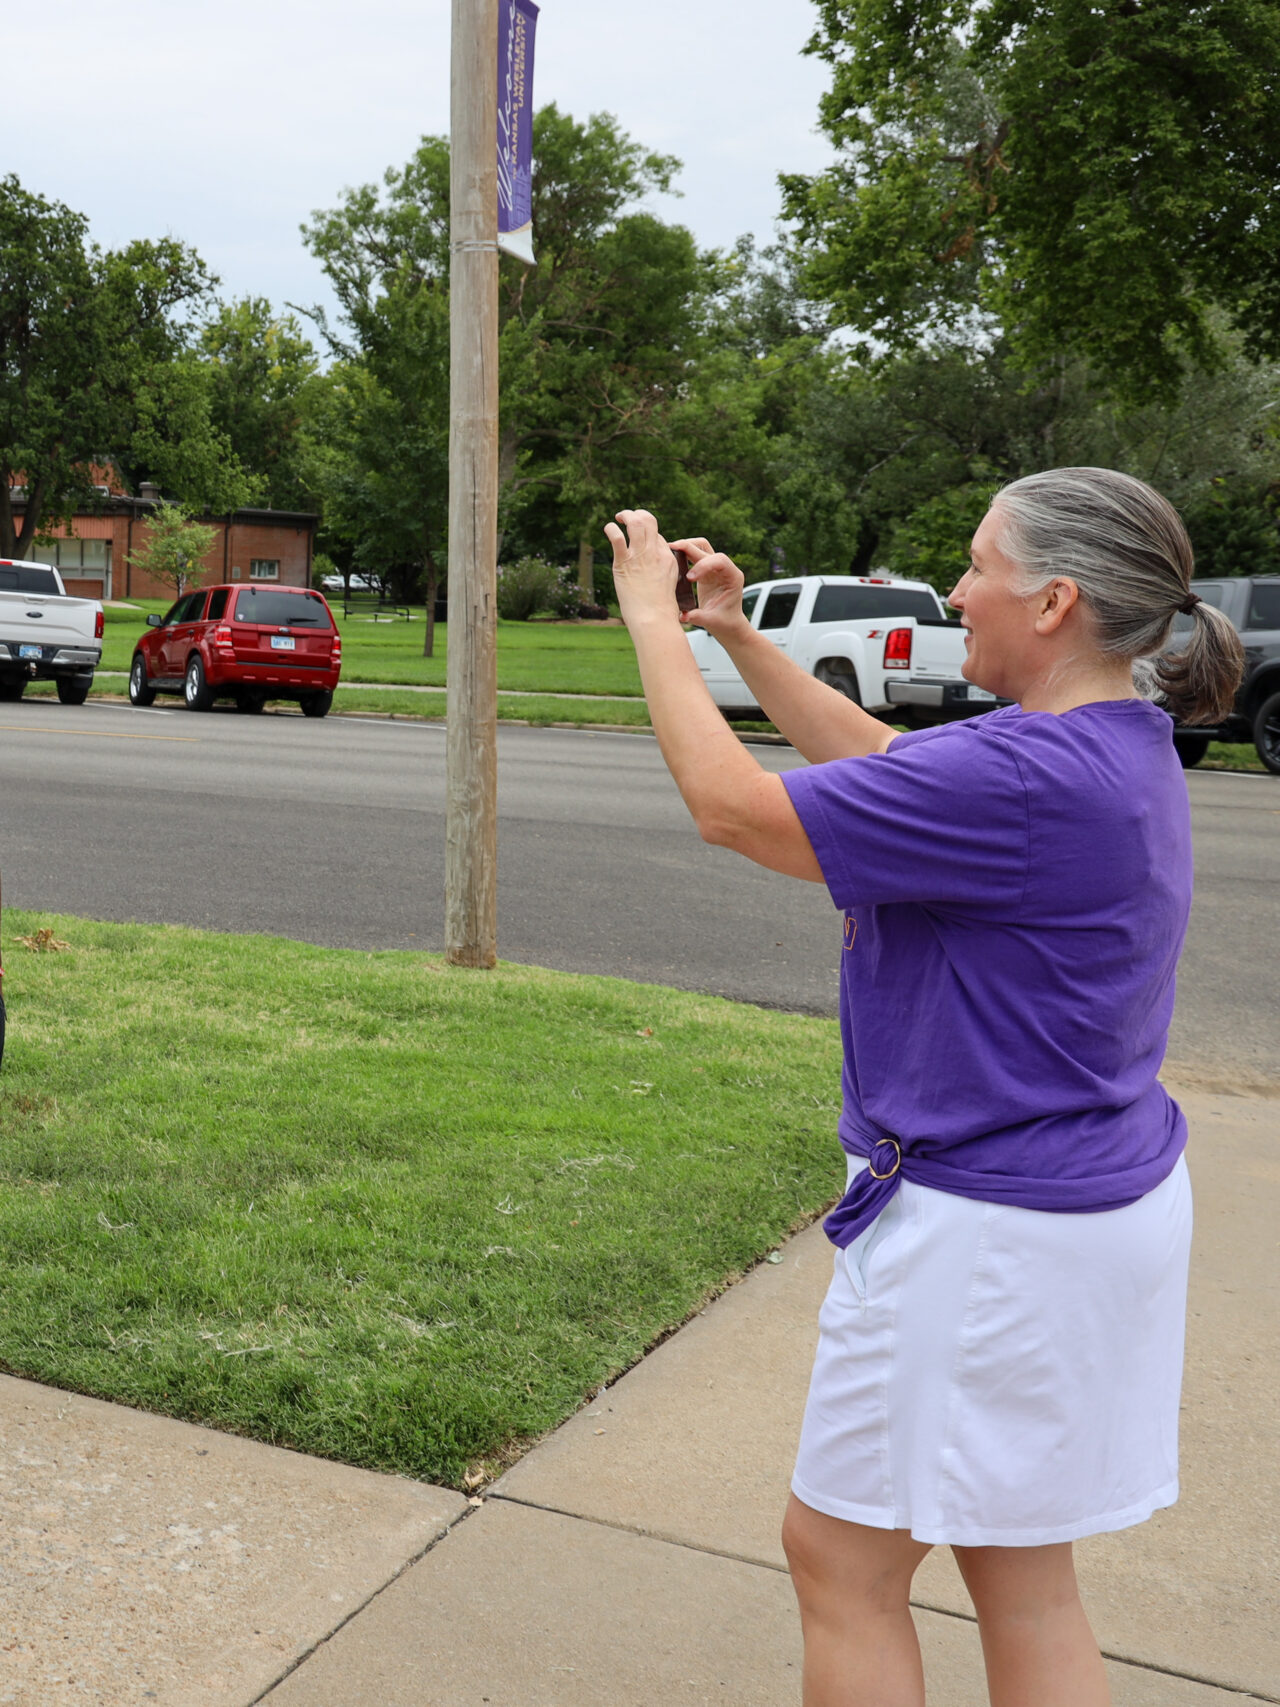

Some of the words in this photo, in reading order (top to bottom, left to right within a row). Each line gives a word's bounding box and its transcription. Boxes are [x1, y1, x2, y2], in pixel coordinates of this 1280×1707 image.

[513, 12, 522, 97] WESLEYAN
[518, 16, 526, 108] UNIVERSITY
[496, 0, 515, 211] Welcome
[511, 102, 519, 165] KANSAS
